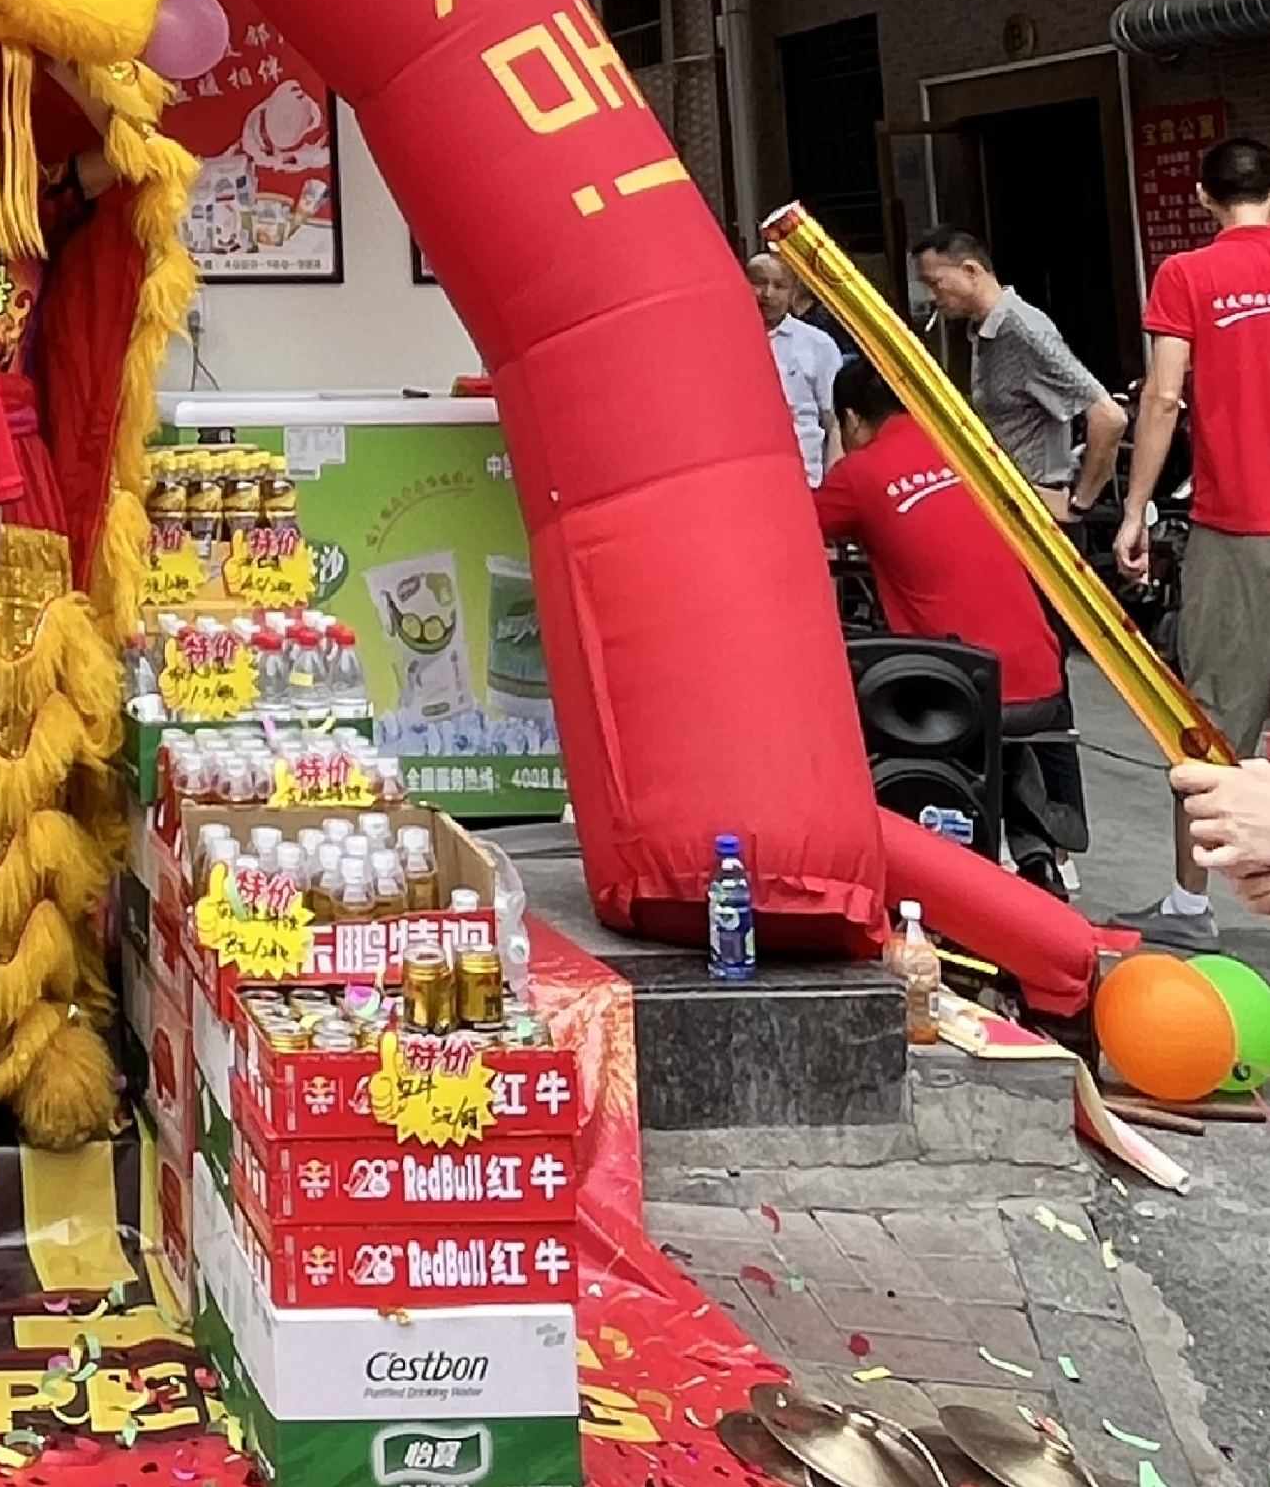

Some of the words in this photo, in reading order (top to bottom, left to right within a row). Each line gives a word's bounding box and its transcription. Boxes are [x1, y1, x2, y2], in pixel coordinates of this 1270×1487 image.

[249, 526, 300, 556] 特价
[184, 627, 239, 663] 特价
[295, 751, 351, 786] 特价
[234, 867, 297, 911] 特价
[403, 1033, 477, 1077] 特价
[491, 1068, 571, 1115] 红牛
[402, 1154, 483, 1202] RedBull
[485, 1154, 568, 1201] 红牛
[406, 1239, 489, 1288] RedBull
[491, 1237, 571, 1286] 红牛
